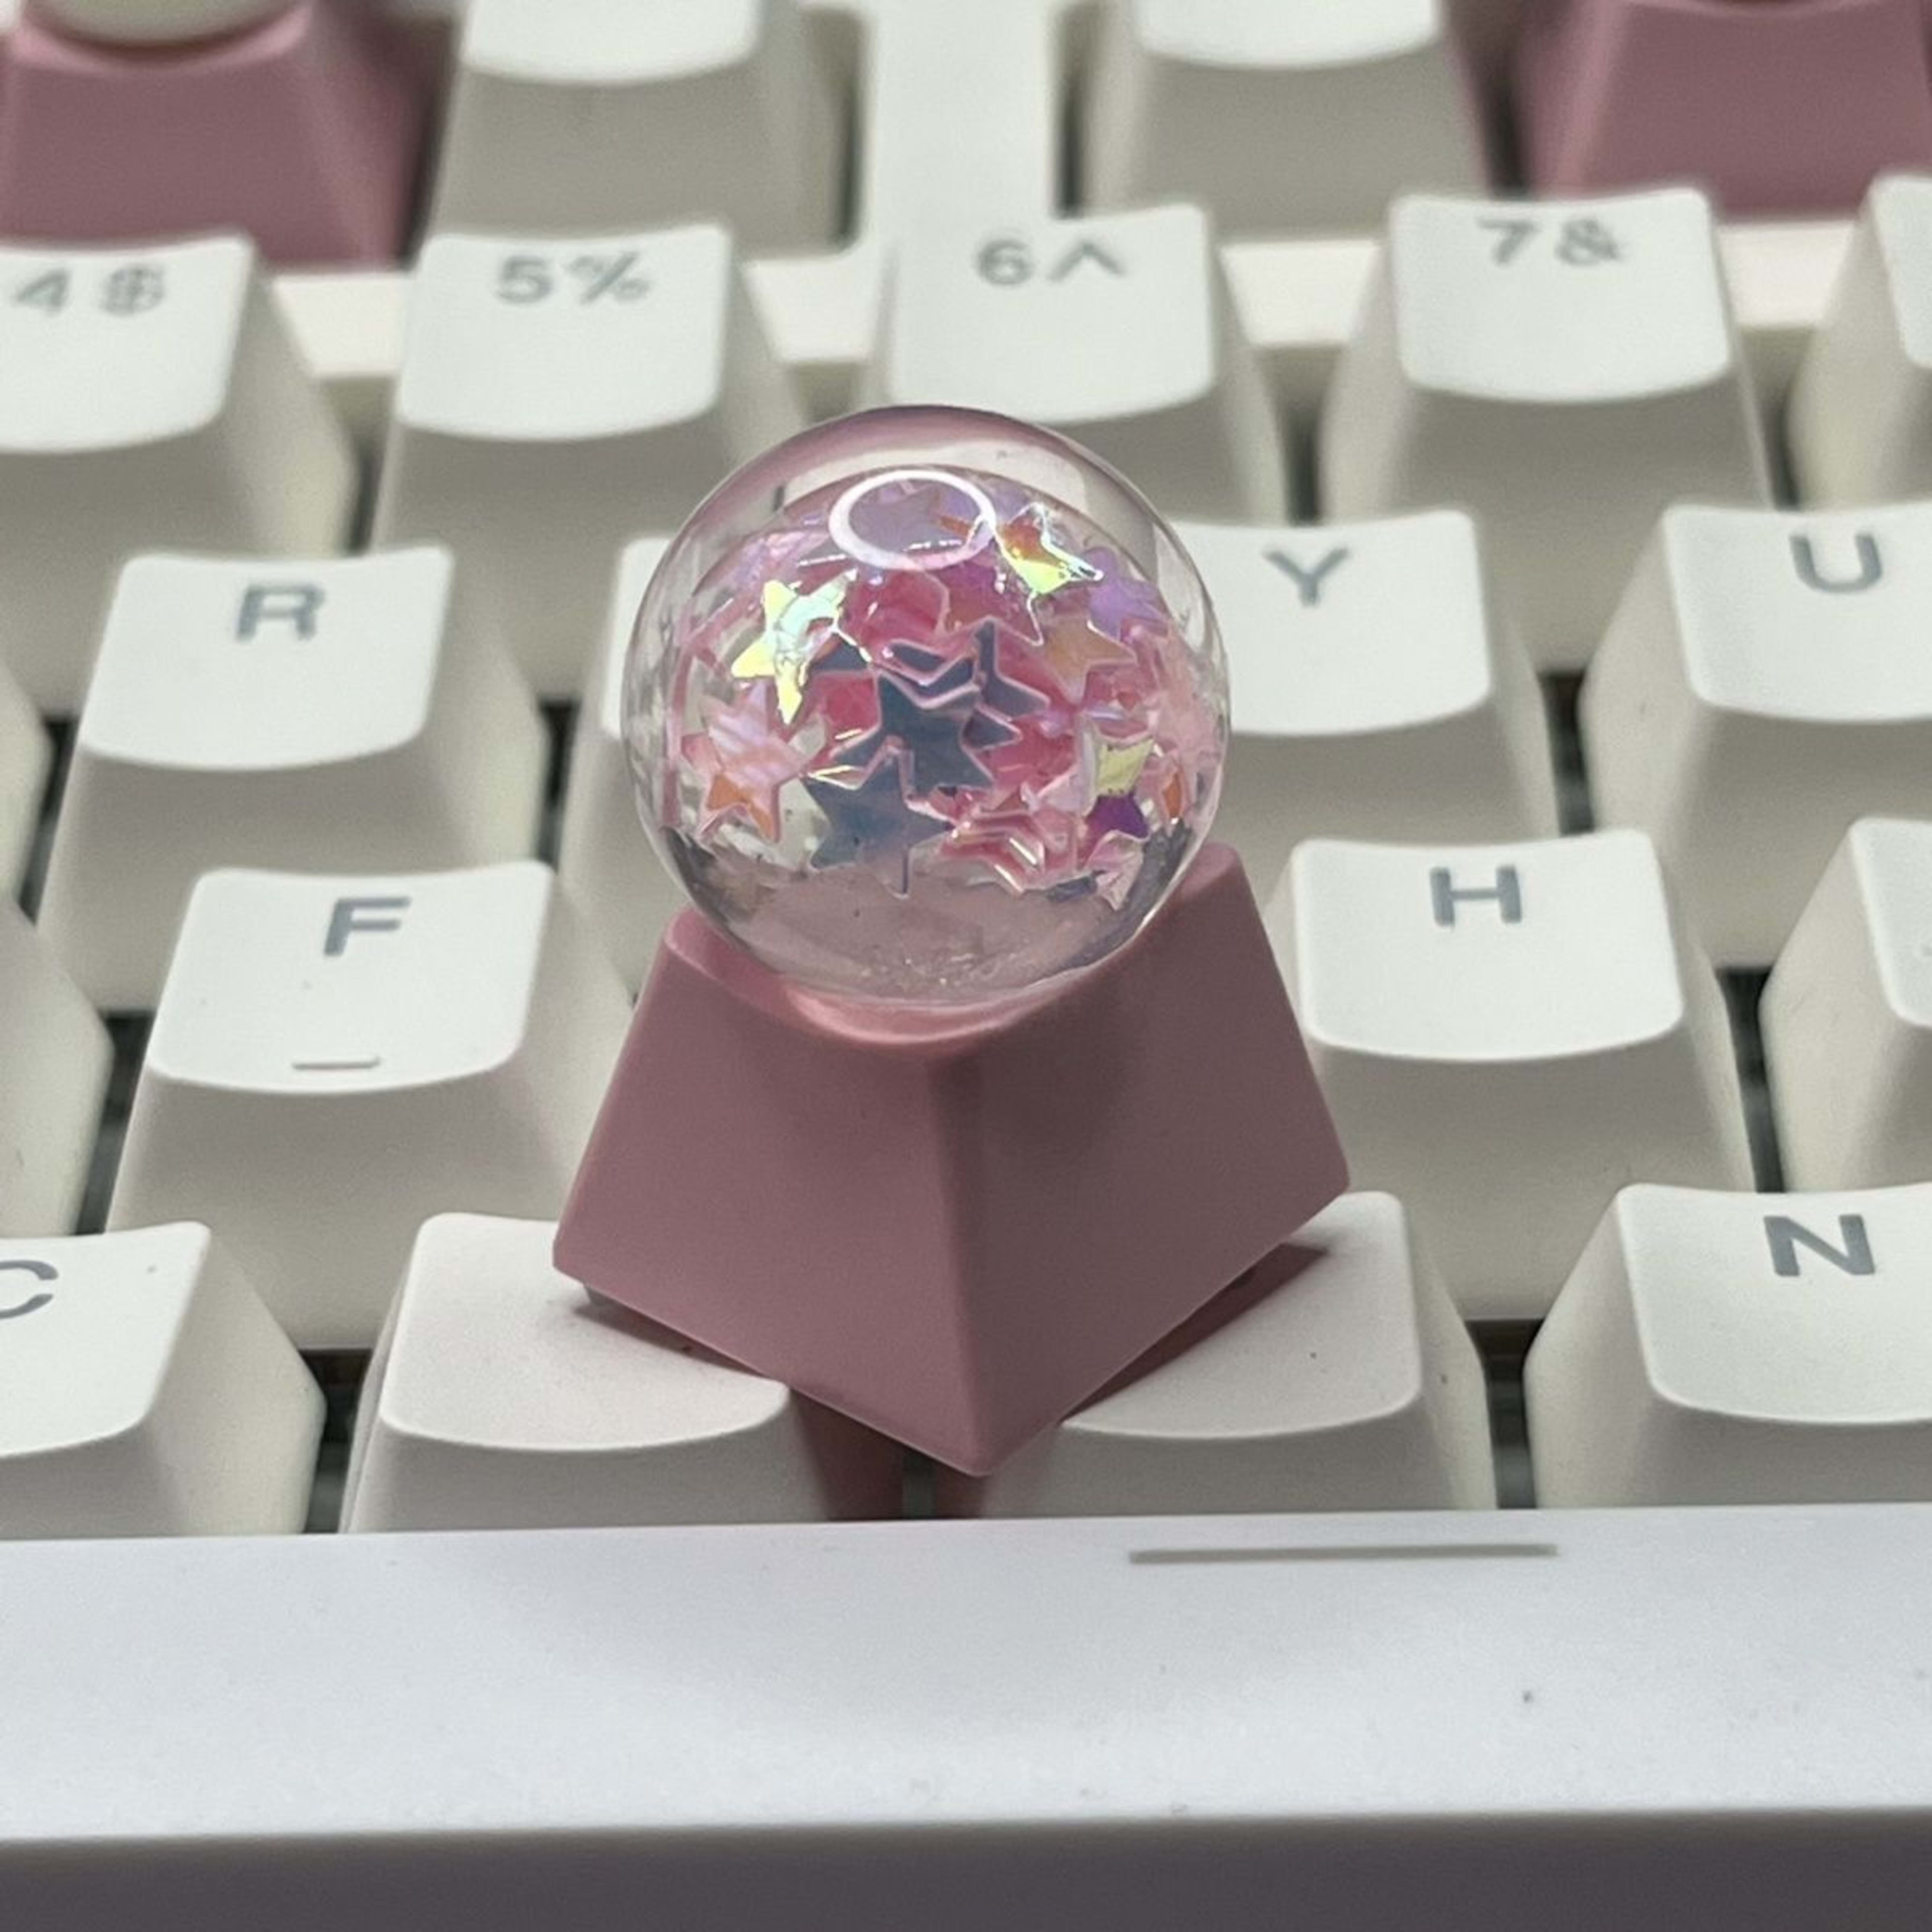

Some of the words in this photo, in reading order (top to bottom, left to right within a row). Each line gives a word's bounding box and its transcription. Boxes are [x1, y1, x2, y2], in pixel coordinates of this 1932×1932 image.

[1265, 548, 1349, 606] Y
[1790, 533, 1883, 593] U
[235, 584, 325, 641] R
[1430, 865, 1522, 927] H
[324, 897, 410, 956] F
[1764, 1215, 1876, 1277] N
